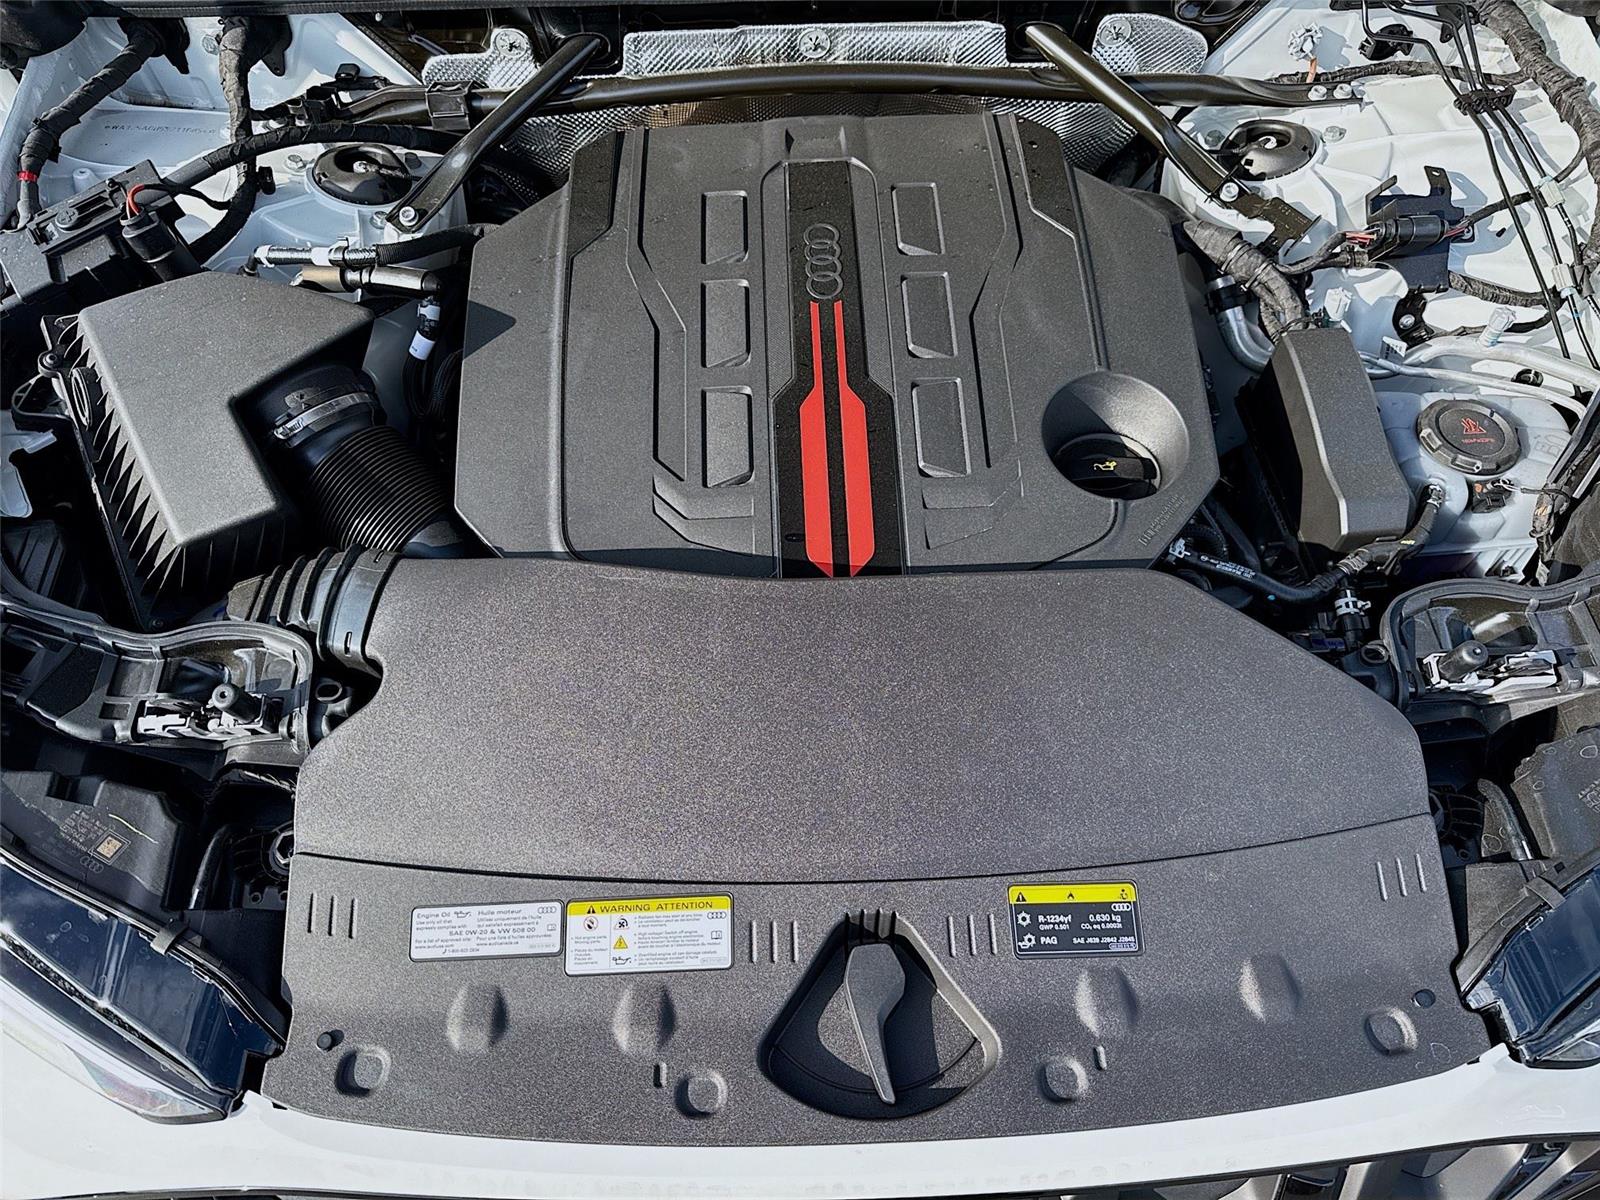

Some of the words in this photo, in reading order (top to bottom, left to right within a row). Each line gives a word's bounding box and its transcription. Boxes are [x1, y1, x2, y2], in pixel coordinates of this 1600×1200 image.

[600, 903, 650, 913] WARNING
[656, 901, 713, 912] ATTENTION
[1038, 914, 1072, 923] R-1234yf
[1111, 913, 1121, 922] kg
[1040, 936, 1058, 945] PAG
